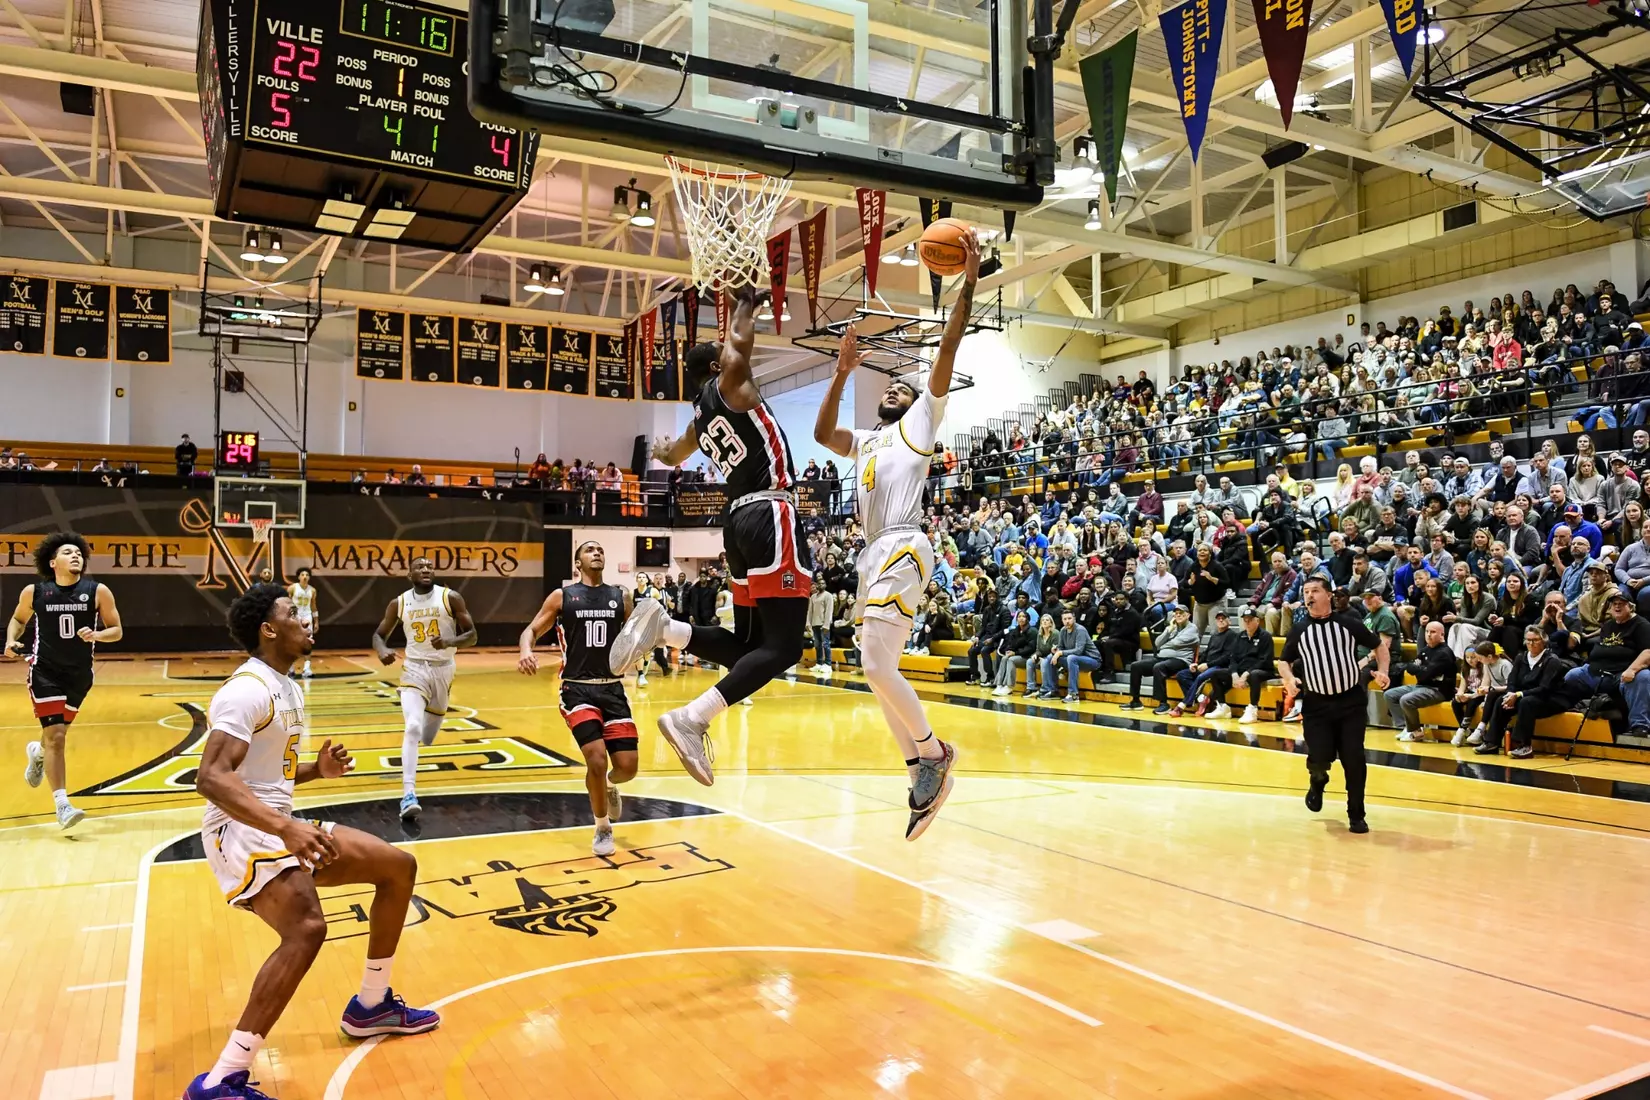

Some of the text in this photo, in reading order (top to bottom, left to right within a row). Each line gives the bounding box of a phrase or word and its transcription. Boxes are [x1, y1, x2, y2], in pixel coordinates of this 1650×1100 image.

[267, 18, 323, 44] VILLE
[362, 4, 448, 50] 11:16
[228, 0, 240, 136] LLERSVILLE
[274, 41, 319, 81] 22
[337, 55, 367, 70] POSS
[373, 49, 418, 67] PERIOD
[1182, 9, 1196, 118] JOHNSTOWN
[257, 75, 299, 92] FOULS
[336, 74, 372, 90] BONUS
[398, 68, 404, 97] 1
[423, 73, 450, 88] POSS
[272, 93, 290, 127] 5
[359, 94, 445, 121] PLAYER FOUL
[414, 90, 449, 106] BONUS
[251, 126, 298, 143] SCORE
[391, 150, 434, 166] MATCH
[492, 136, 510, 167] 4
[474, 166, 515, 181] SCORE
[863, 192, 872, 245] HAVEN
[773, 239, 784, 286] IUP
[4, 302, 36, 310] FOOTBALL
[1347, 314, 1355, 326] D
[226, 444, 252, 463] 29
[699, 415, 747, 478] 23
[862, 455, 877, 493] 4
[108, 543, 186, 568] THE
[646, 538, 653, 550] 3
[309, 540, 519, 577] MARAUDERS
[46, 604, 88, 612] WARRIORS
[407, 607, 440, 620] VILLE
[576, 610, 615, 618] WARRIORS
[59, 614, 75, 639] 0
[411, 619, 440, 643] 34
[585, 620, 608, 647] 10
[283, 734, 300, 780] 5
